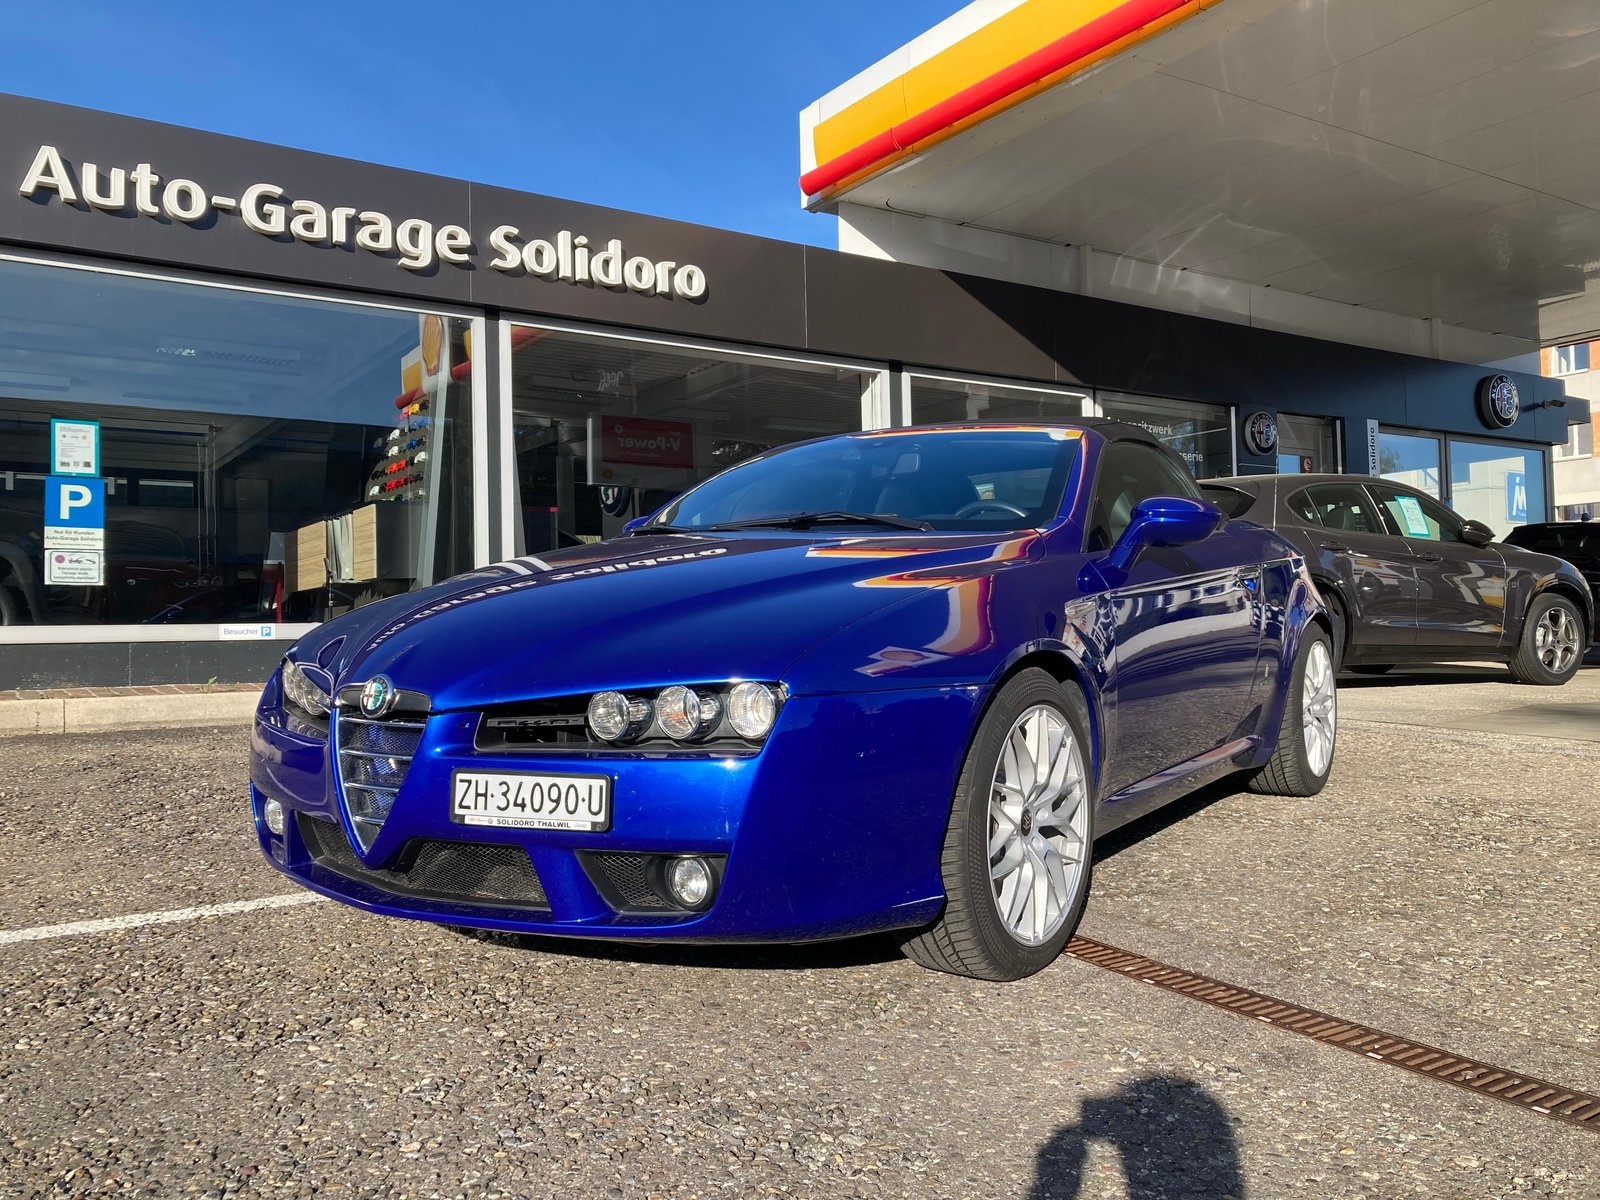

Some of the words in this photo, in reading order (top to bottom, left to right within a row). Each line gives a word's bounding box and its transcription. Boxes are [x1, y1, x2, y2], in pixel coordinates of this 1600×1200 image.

[19, 145, 472, 270] Auto-Garage
[489, 224, 707, 299] Solidoro
[1369, 427, 1377, 470] Solidoro
[60, 484, 92, 519] P
[263, 627, 270, 636] P
[496, 819, 535, 827] SOLIDORO
